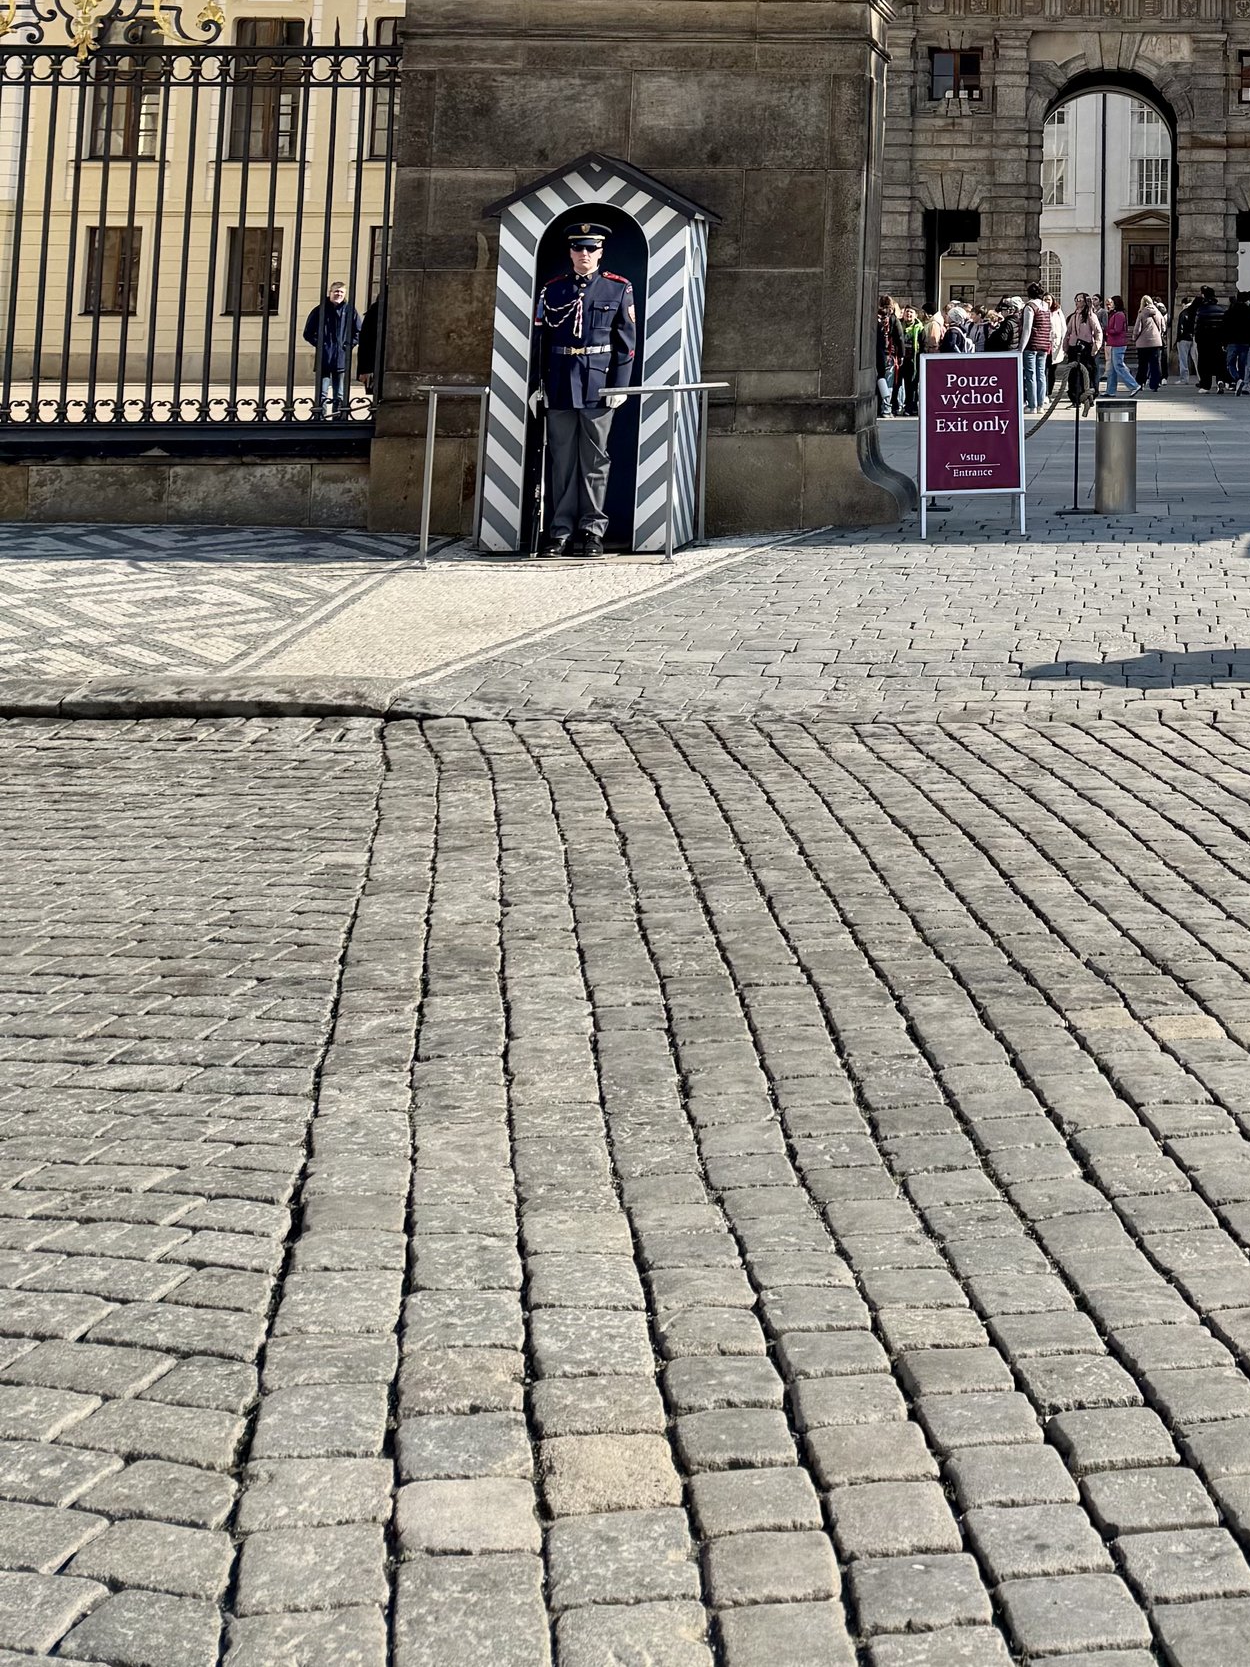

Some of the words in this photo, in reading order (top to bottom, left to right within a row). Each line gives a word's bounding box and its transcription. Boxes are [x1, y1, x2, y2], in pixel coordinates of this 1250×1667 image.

[946, 374, 998, 387] Pouze
[941, 389, 1004, 409] východ
[935, 417, 968, 433] Exit
[972, 416, 1009, 434] only
[960, 453, 986, 462] Vstup
[953, 468, 993, 477] Entrance
